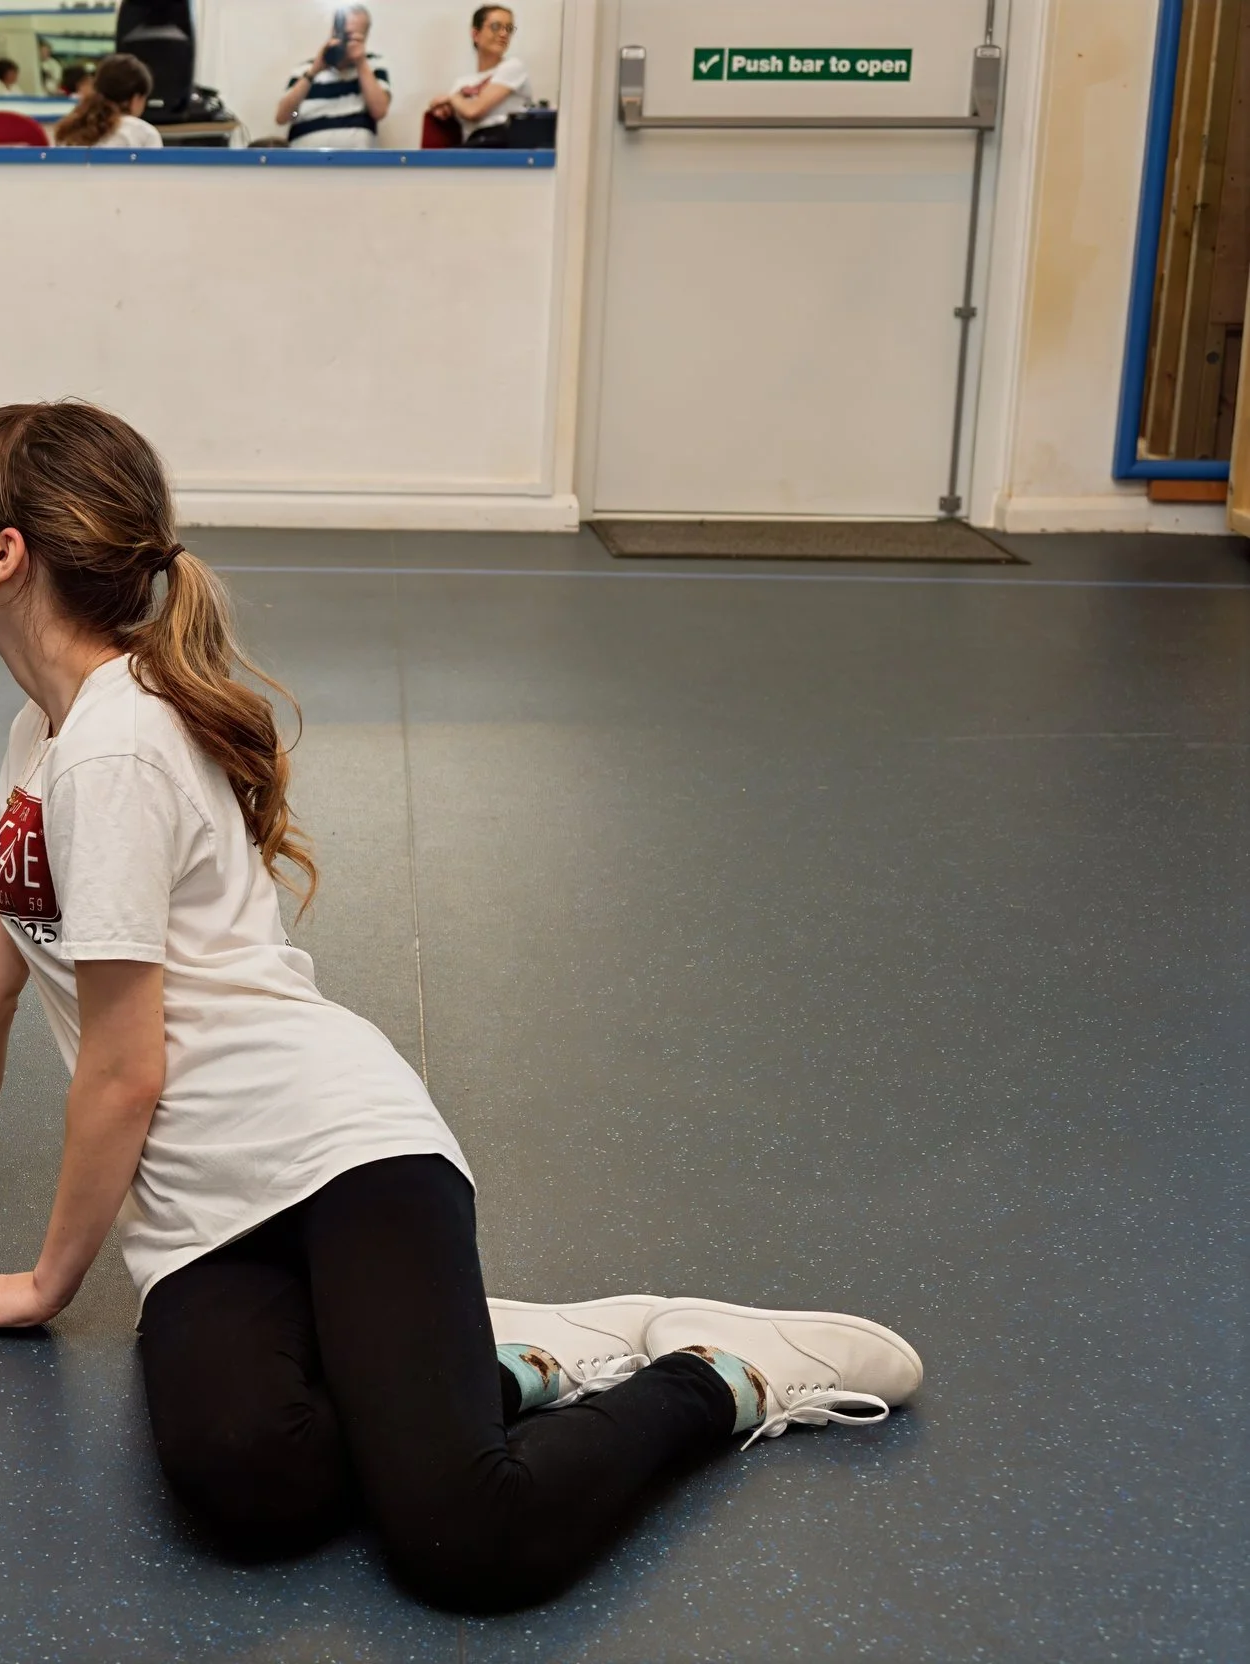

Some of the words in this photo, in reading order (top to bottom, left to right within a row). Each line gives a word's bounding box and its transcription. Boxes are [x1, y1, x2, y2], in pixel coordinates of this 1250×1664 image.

[731, 55, 783, 73] Push
[789, 55, 824, 73] bar
[829, 56, 851, 73] to
[856, 58, 908, 77] open
[28, 897, 43, 911] 59
